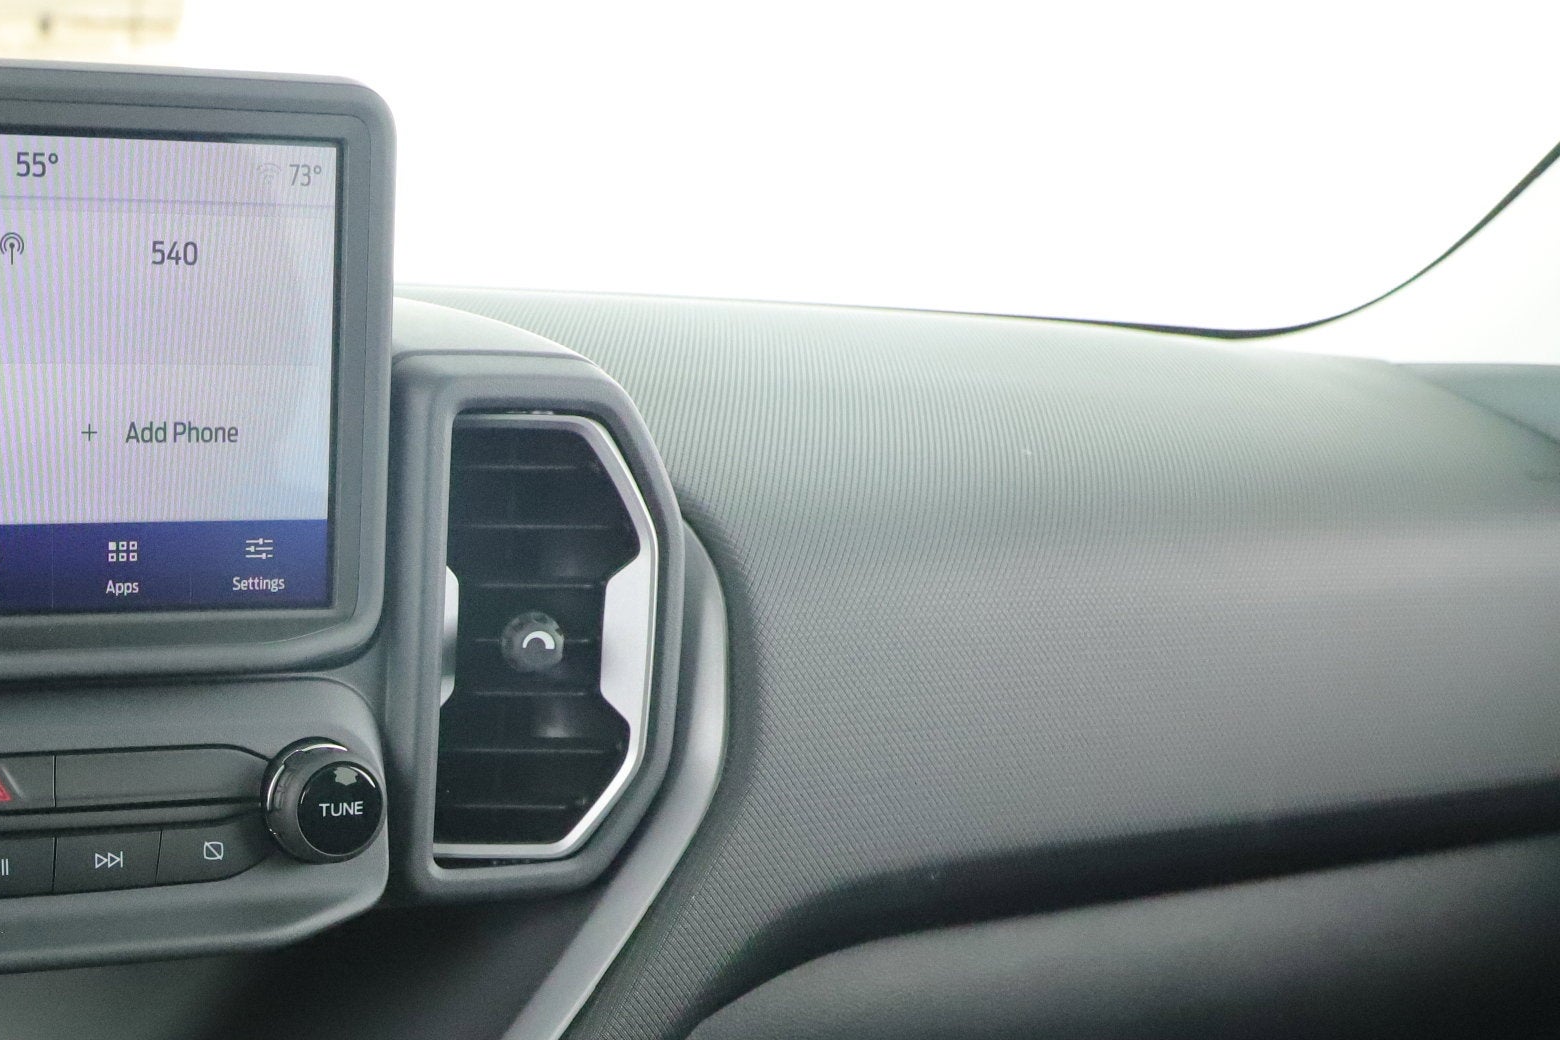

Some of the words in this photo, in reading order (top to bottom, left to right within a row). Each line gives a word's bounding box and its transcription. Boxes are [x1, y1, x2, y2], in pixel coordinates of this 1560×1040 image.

[151, 240, 199, 266] 540
[125, 421, 167, 444] Add
[173, 420, 239, 443] Phone
[105, 579, 140, 596] Apps
[232, 575, 286, 592] Settings
[318, 800, 364, 817] TUNE
